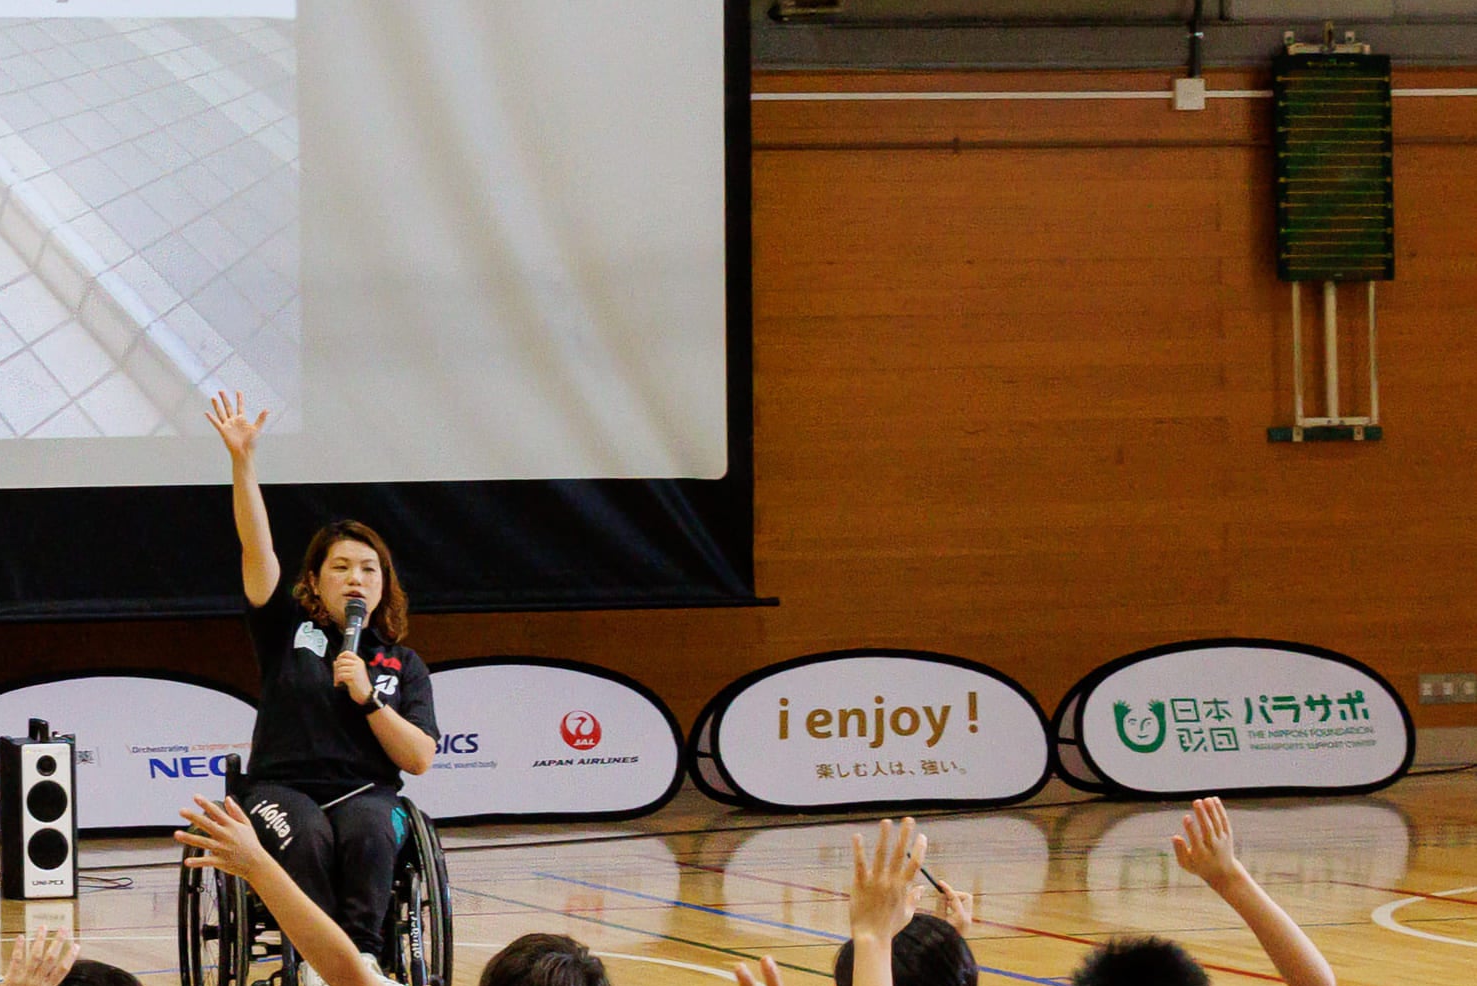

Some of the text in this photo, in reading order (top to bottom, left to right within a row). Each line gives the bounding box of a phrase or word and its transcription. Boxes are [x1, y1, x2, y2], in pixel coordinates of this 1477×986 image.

[778, 697, 789, 740] i
[1244, 689, 1370, 724] パラサポ
[149, 755, 227, 779] NEC
[532, 756, 640, 768] JAPAN AIRLINES
